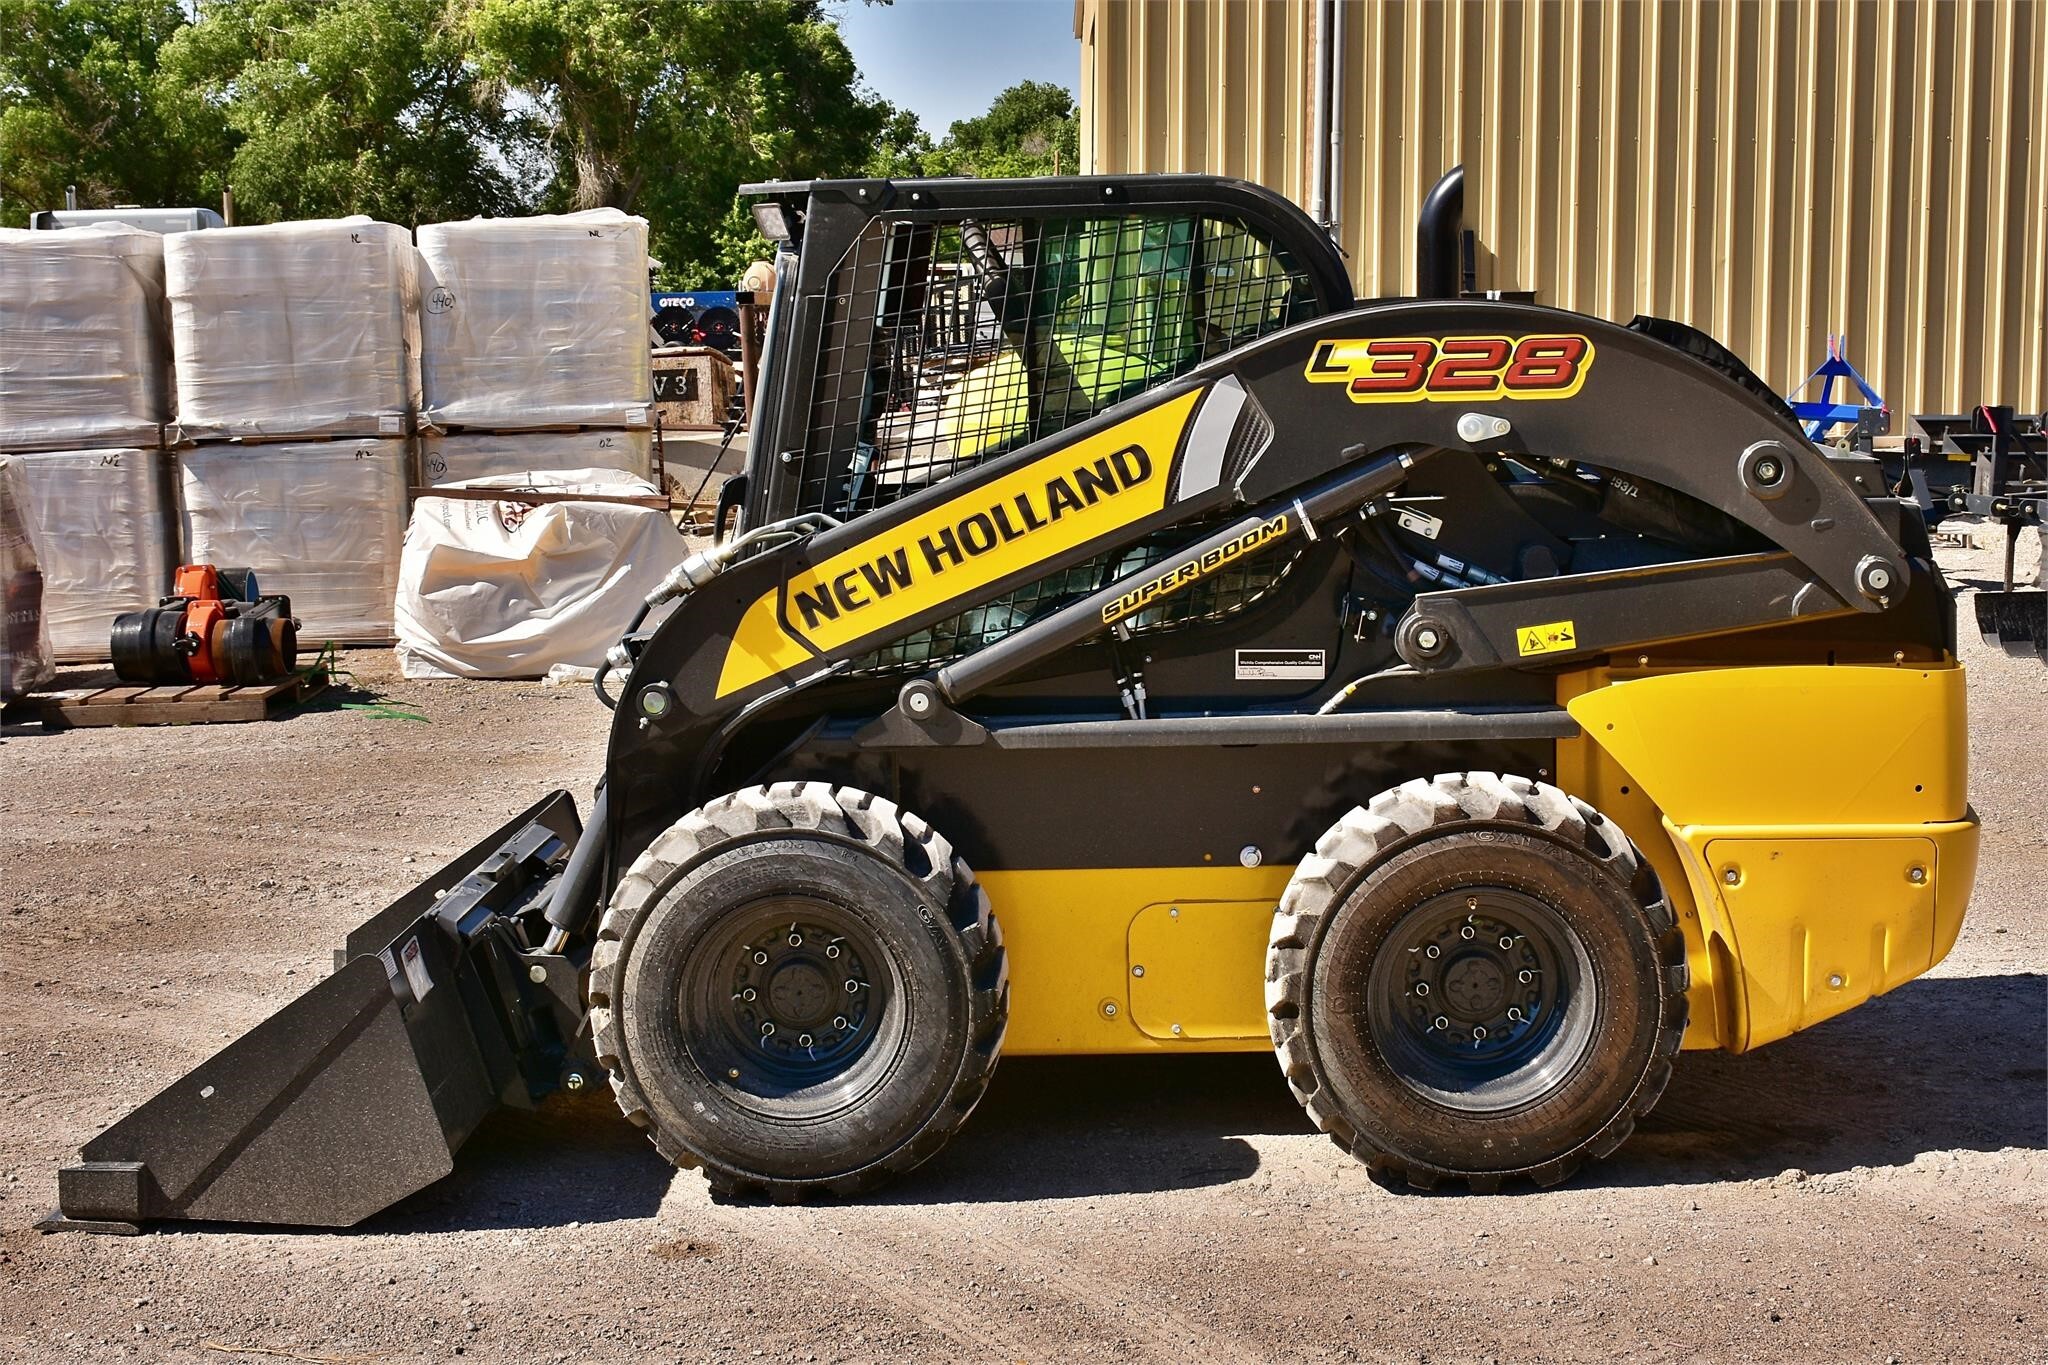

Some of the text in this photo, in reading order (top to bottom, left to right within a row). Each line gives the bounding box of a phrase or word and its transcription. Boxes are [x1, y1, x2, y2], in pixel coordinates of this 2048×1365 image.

[659, 297, 696, 308] OTECO
[1306, 335, 1595, 402] L328
[794, 444, 1153, 631] NEW HOLLAND
[1102, 514, 1288, 624] SUPER BOOM
